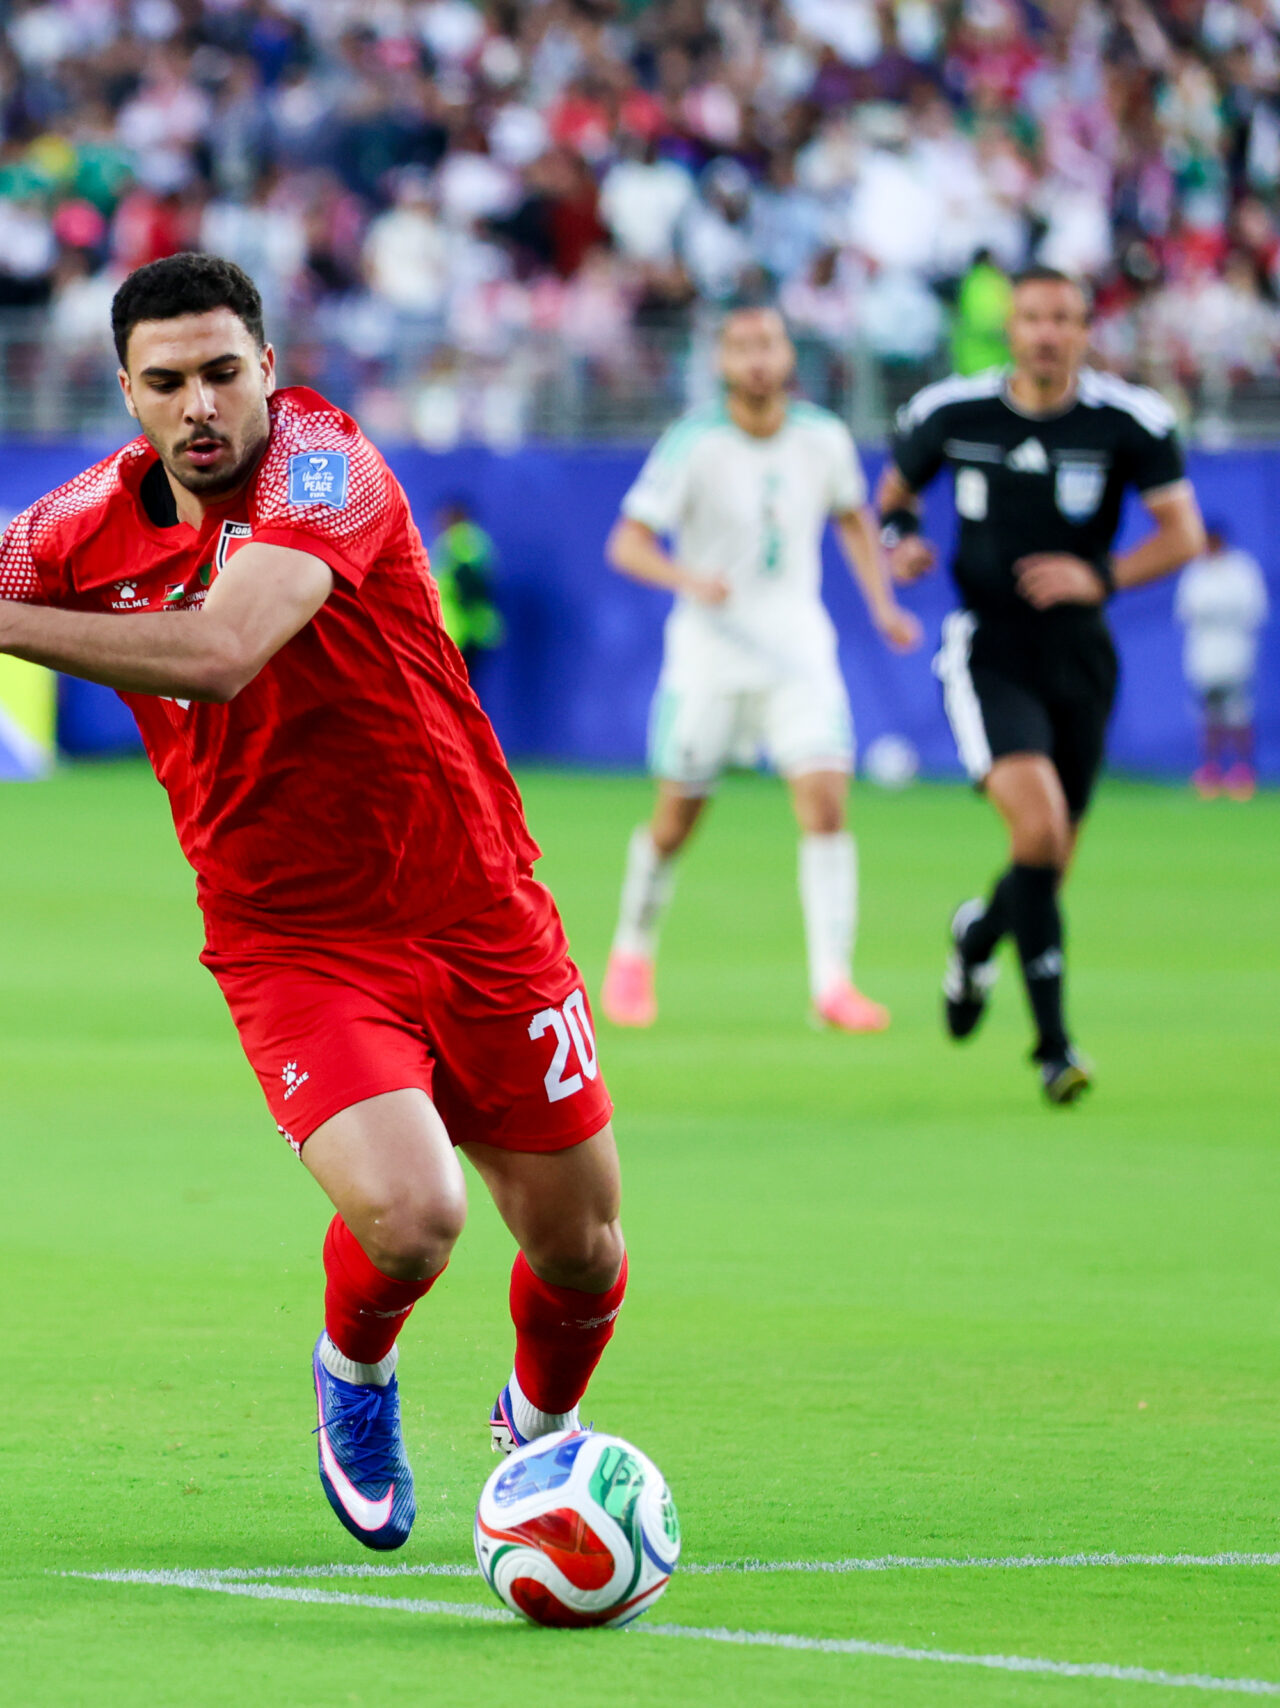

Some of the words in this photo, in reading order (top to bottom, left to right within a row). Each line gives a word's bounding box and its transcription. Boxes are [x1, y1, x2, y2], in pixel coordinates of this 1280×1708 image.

[304, 481, 333, 492] PEACE
[111, 597, 150, 609] KELME
[527, 987, 598, 1104] 20
[283, 1071, 310, 1101] KELME
